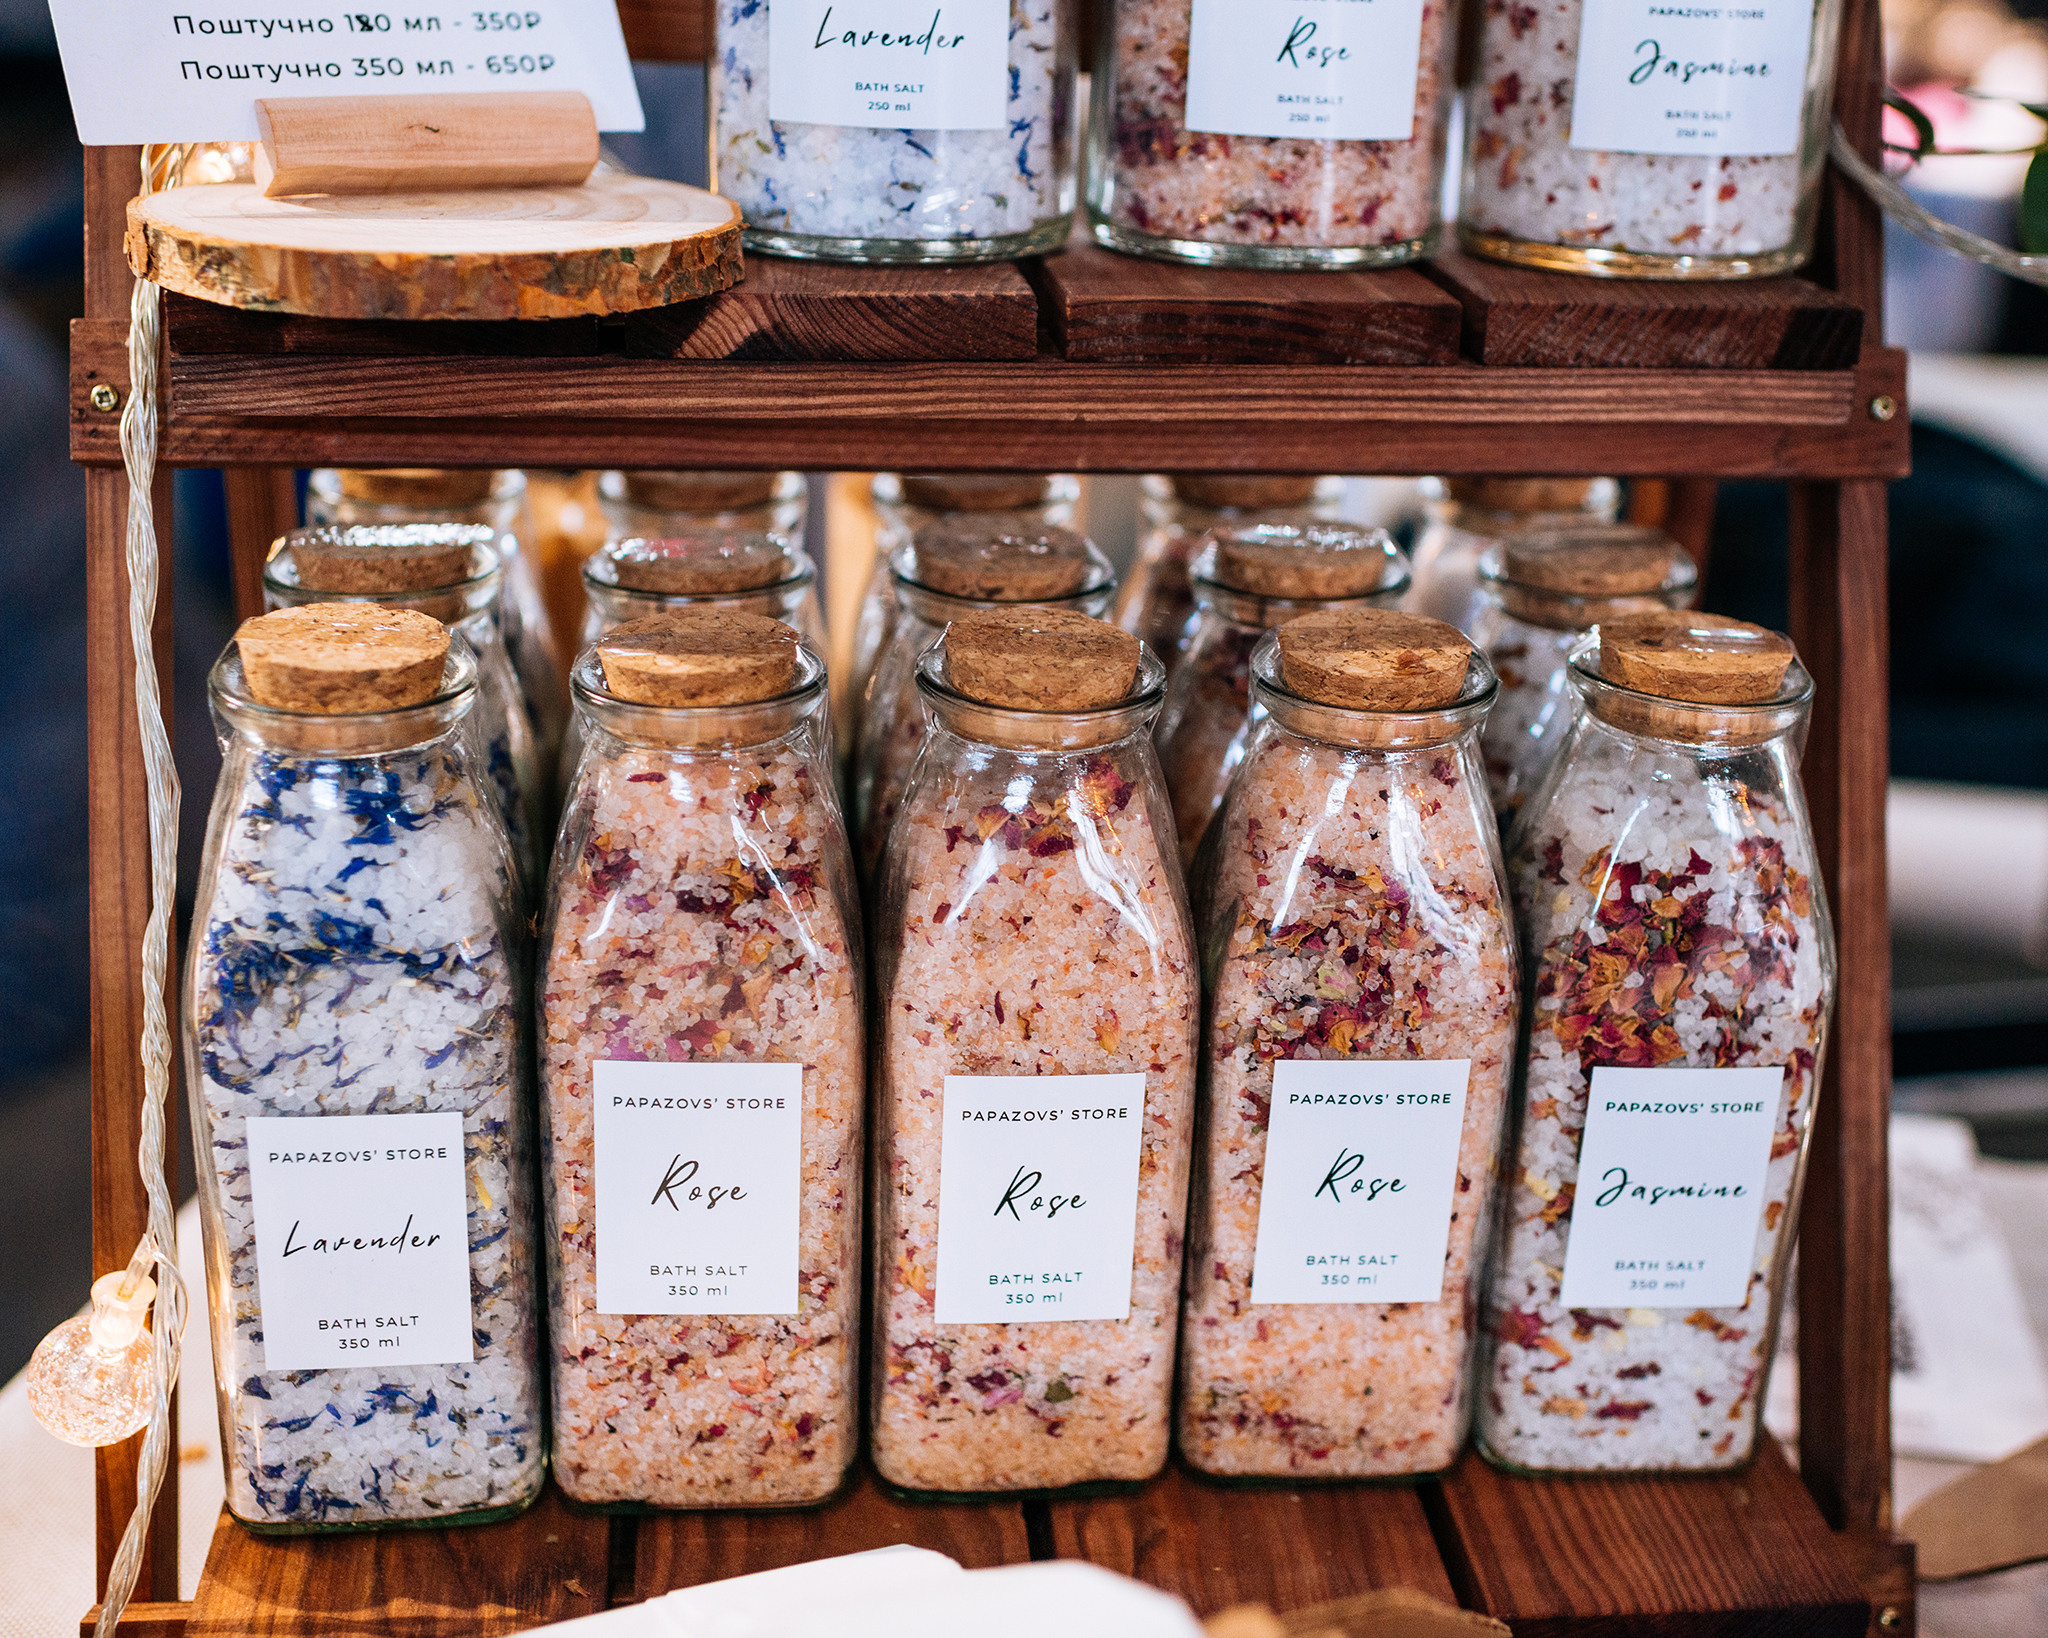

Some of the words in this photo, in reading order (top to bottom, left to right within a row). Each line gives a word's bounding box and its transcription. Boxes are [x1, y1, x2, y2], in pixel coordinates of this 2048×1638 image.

[172, 15, 334, 39] Поштучно
[403, 16, 441, 32] мл
[813, 5, 965, 56] Lavender
[1276, 15, 1350, 69] Rose
[1628, 38, 1771, 86] Jasmine
[180, 60, 342, 84] Поштучно
[351, 57, 404, 77] 350
[415, 59, 455, 76] мл
[854, 81, 889, 92] BATH
[893, 83, 925, 94] SALT
[1276, 93, 1311, 104] BATH
[867, 100, 890, 111] 250
[894, 102, 911, 112] ml
[726, 1097, 786, 1110] STORE
[1395, 1093, 1452, 1106] STORE
[1071, 1107, 1128, 1121] STORE
[1710, 1101, 1765, 1114] STORE
[386, 1147, 448, 1161] STORE
[650, 1153, 748, 1212] Rose
[1314, 1147, 1407, 1204] Rose
[993, 1165, 1087, 1222] Rose
[1594, 1167, 1747, 1208] Jasmine
[282, 1213, 441, 1258] Lavender
[1305, 1255, 1351, 1267] BATH
[1357, 1254, 1399, 1266] SALT
[1614, 1260, 1660, 1272] BATH
[1665, 1259, 1705, 1272] SALT
[649, 1264, 697, 1276] BATH
[704, 1265, 748, 1277] SALT
[988, 1274, 1034, 1286] BATH
[1041, 1271, 1083, 1284] SALT
[1320, 1274, 1350, 1286] 350
[1356, 1274, 1378, 1285] ml
[668, 1285, 699, 1297] 350
[706, 1284, 728, 1296] ml
[1005, 1293, 1035, 1305] 350
[1042, 1291, 1063, 1303] ml
[318, 1317, 367, 1331] BATH
[375, 1315, 419, 1328] SALT
[338, 1337, 370, 1350] 350
[378, 1335, 400, 1348] ml
